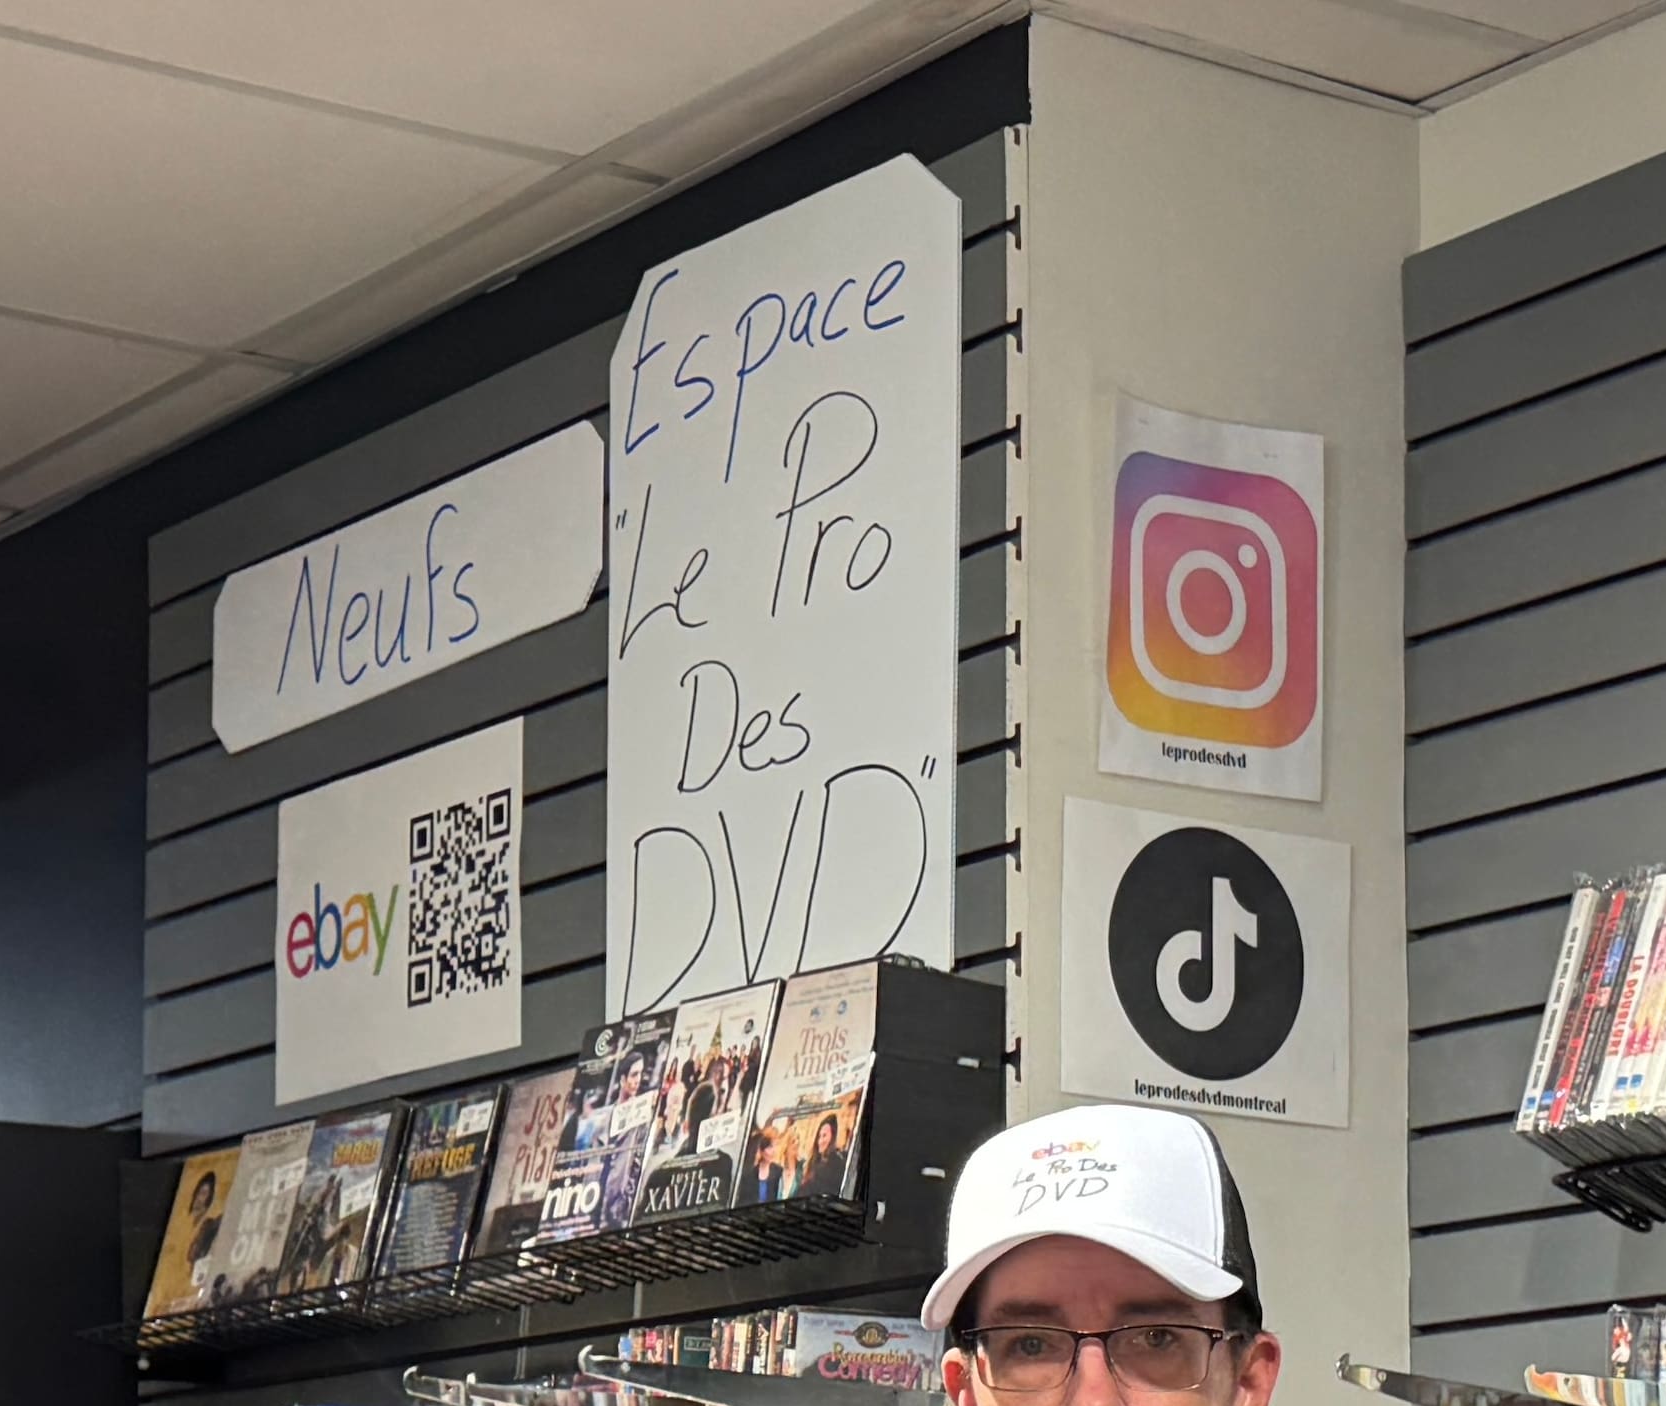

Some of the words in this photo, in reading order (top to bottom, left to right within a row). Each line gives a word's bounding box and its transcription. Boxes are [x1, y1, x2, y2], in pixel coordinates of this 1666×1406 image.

[623, 260, 907, 482] Espace
[772, 392, 893, 617] Pro
[277, 505, 480, 696] Neufs
[678, 661, 810, 793] Des
[1162, 741, 1246, 770] leprodesdvd
[286, 883, 400, 978] ebay
[1632, 956, 1645, 972] LA
[1606, 978, 1636, 1058] DOUBLURE
[800, 1027, 849, 1052] Trois
[785, 1050, 847, 1080] Amies
[1134, 1079, 1286, 1115] leprodesdvdmontreal
[1032, 1139, 1100, 1161] ebay
[1079, 1159, 1117, 1173] Des
[541, 1178, 600, 1219] nino
[645, 1177, 720, 1213] XAVIER
[1015, 1177, 1108, 1217] DVD
